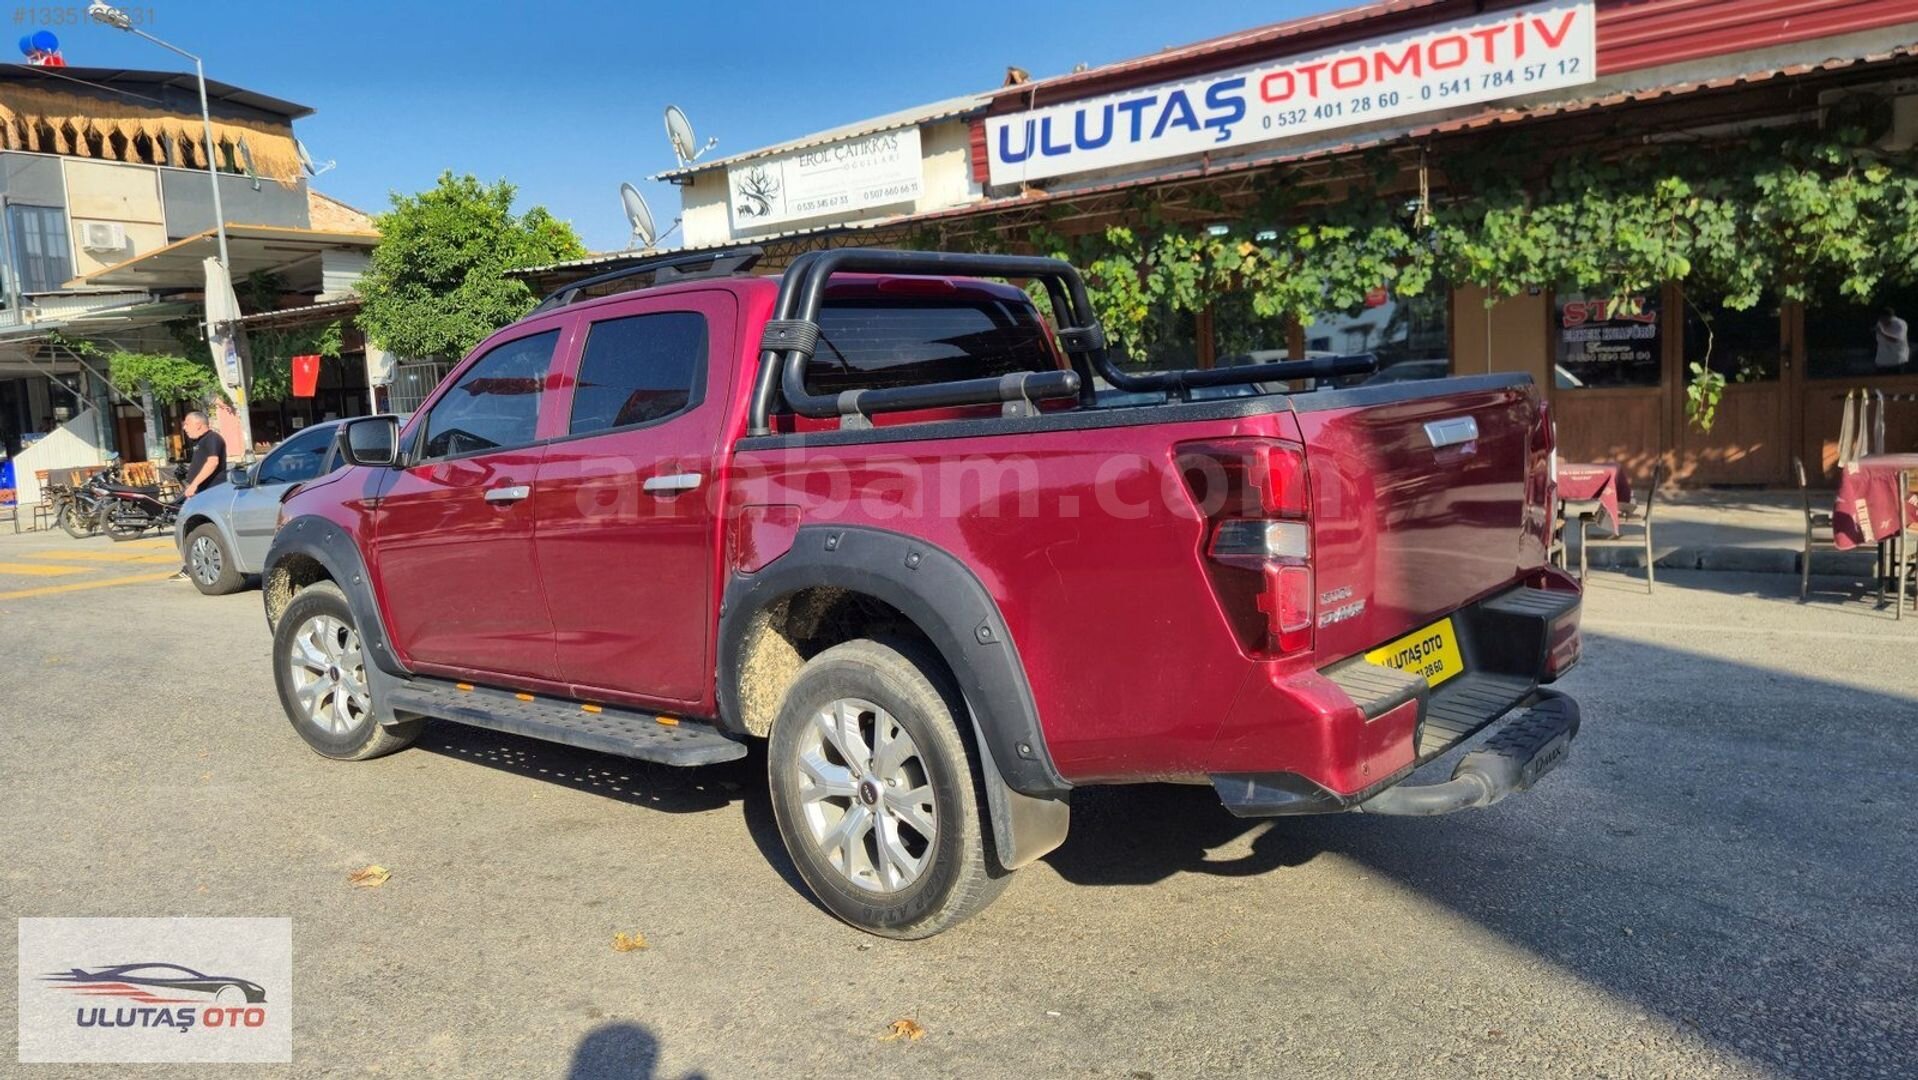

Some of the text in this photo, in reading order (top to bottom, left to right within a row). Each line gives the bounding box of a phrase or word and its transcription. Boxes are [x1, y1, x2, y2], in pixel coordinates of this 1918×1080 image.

[999, 11, 1576, 164] ULUTAŞ OTOMOTİV
[1262, 115, 1271, 129] 0
[1278, 109, 1307, 127] 532
[1314, 102, 1342, 120] 401
[1351, 97, 1371, 113] 28
[1378, 91, 1399, 108] 60
[1421, 85, 1431, 100] 0
[1439, 78, 1470, 97] 541
[1481, 69, 1514, 89] 784
[1524, 63, 1546, 82] 57
[1558, 57, 1580, 75] 12
[799, 148, 832, 168] EROL
[1563, 297, 1656, 328] STL
[1422, 634, 1443, 656] OTO
